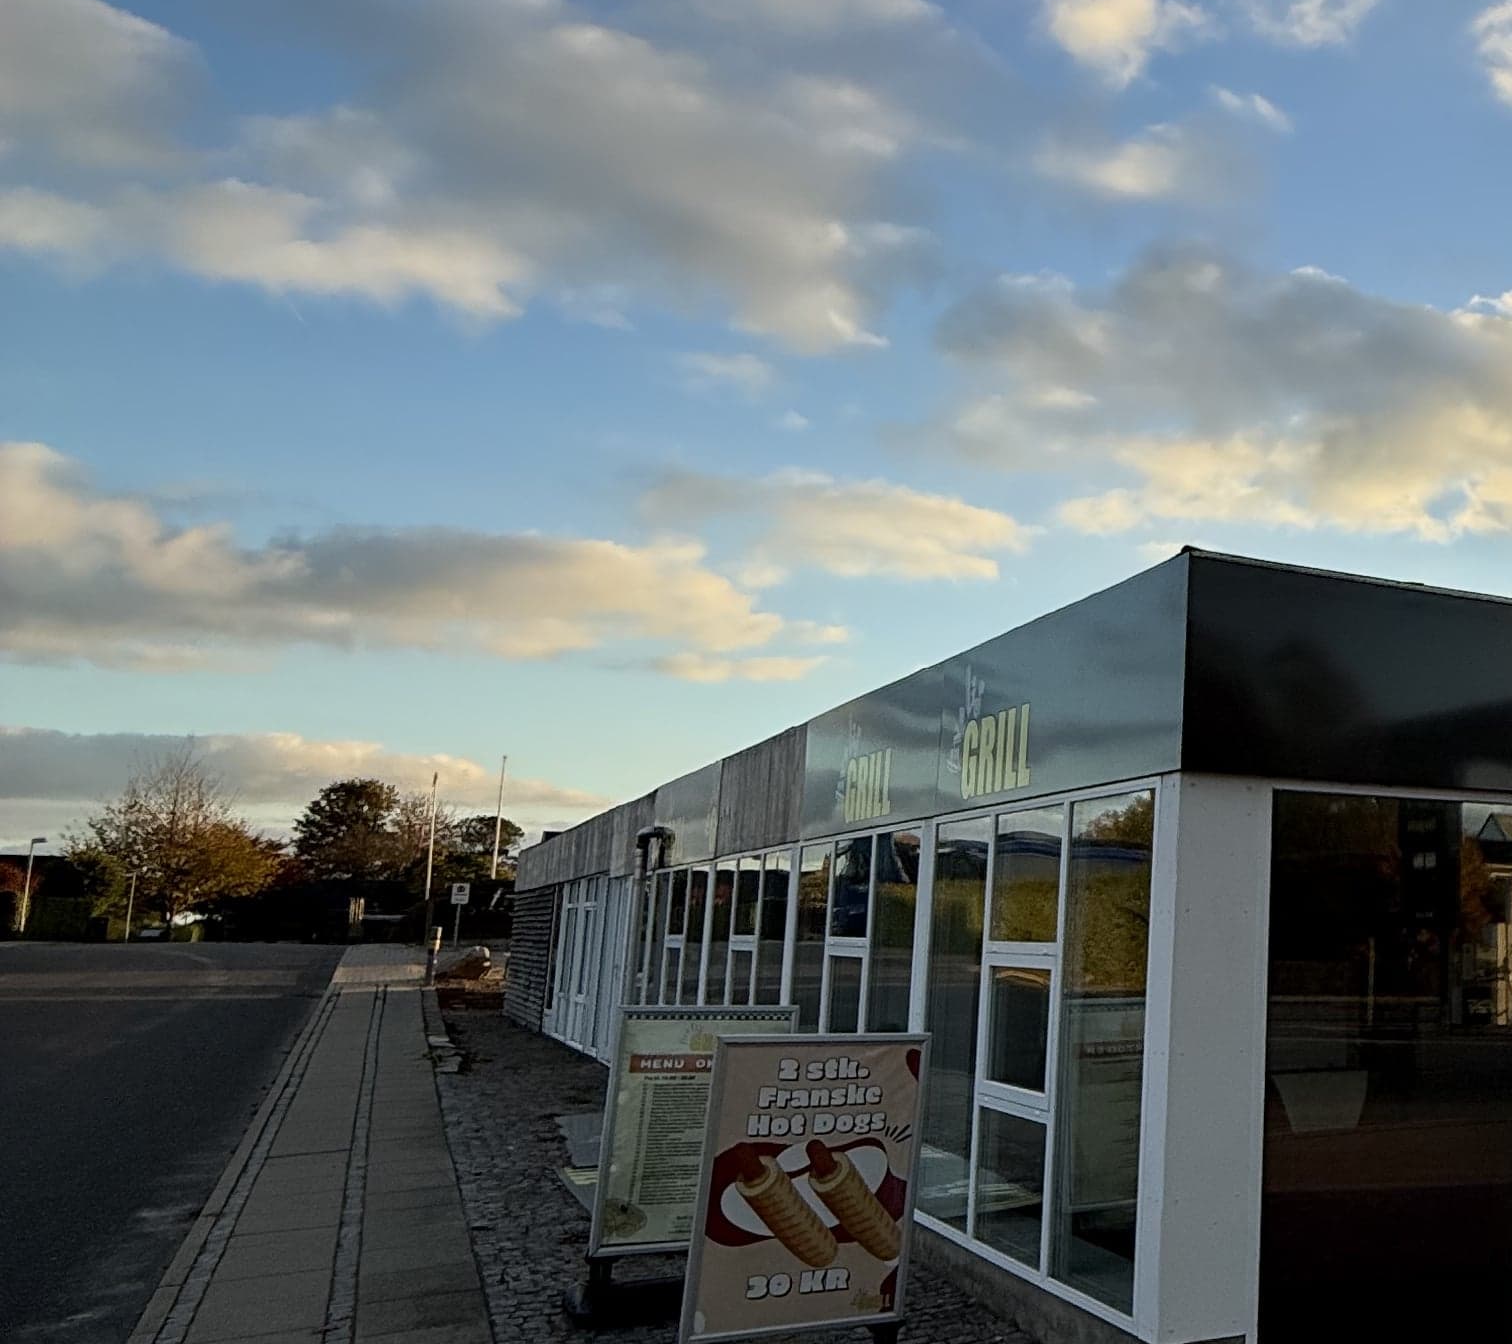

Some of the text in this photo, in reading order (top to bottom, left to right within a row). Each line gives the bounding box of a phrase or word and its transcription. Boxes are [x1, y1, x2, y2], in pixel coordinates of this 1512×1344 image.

[960, 703, 1031, 800] GRILL
[843, 747, 892, 824] GRILL
[640, 1058, 685, 1069] MENU
[778, 1057, 871, 1081] 2 stk.
[757, 1082, 883, 1109] Franske
[747, 1111, 886, 1137] Hot Dogs
[745, 1266, 851, 1300] 30 KR
